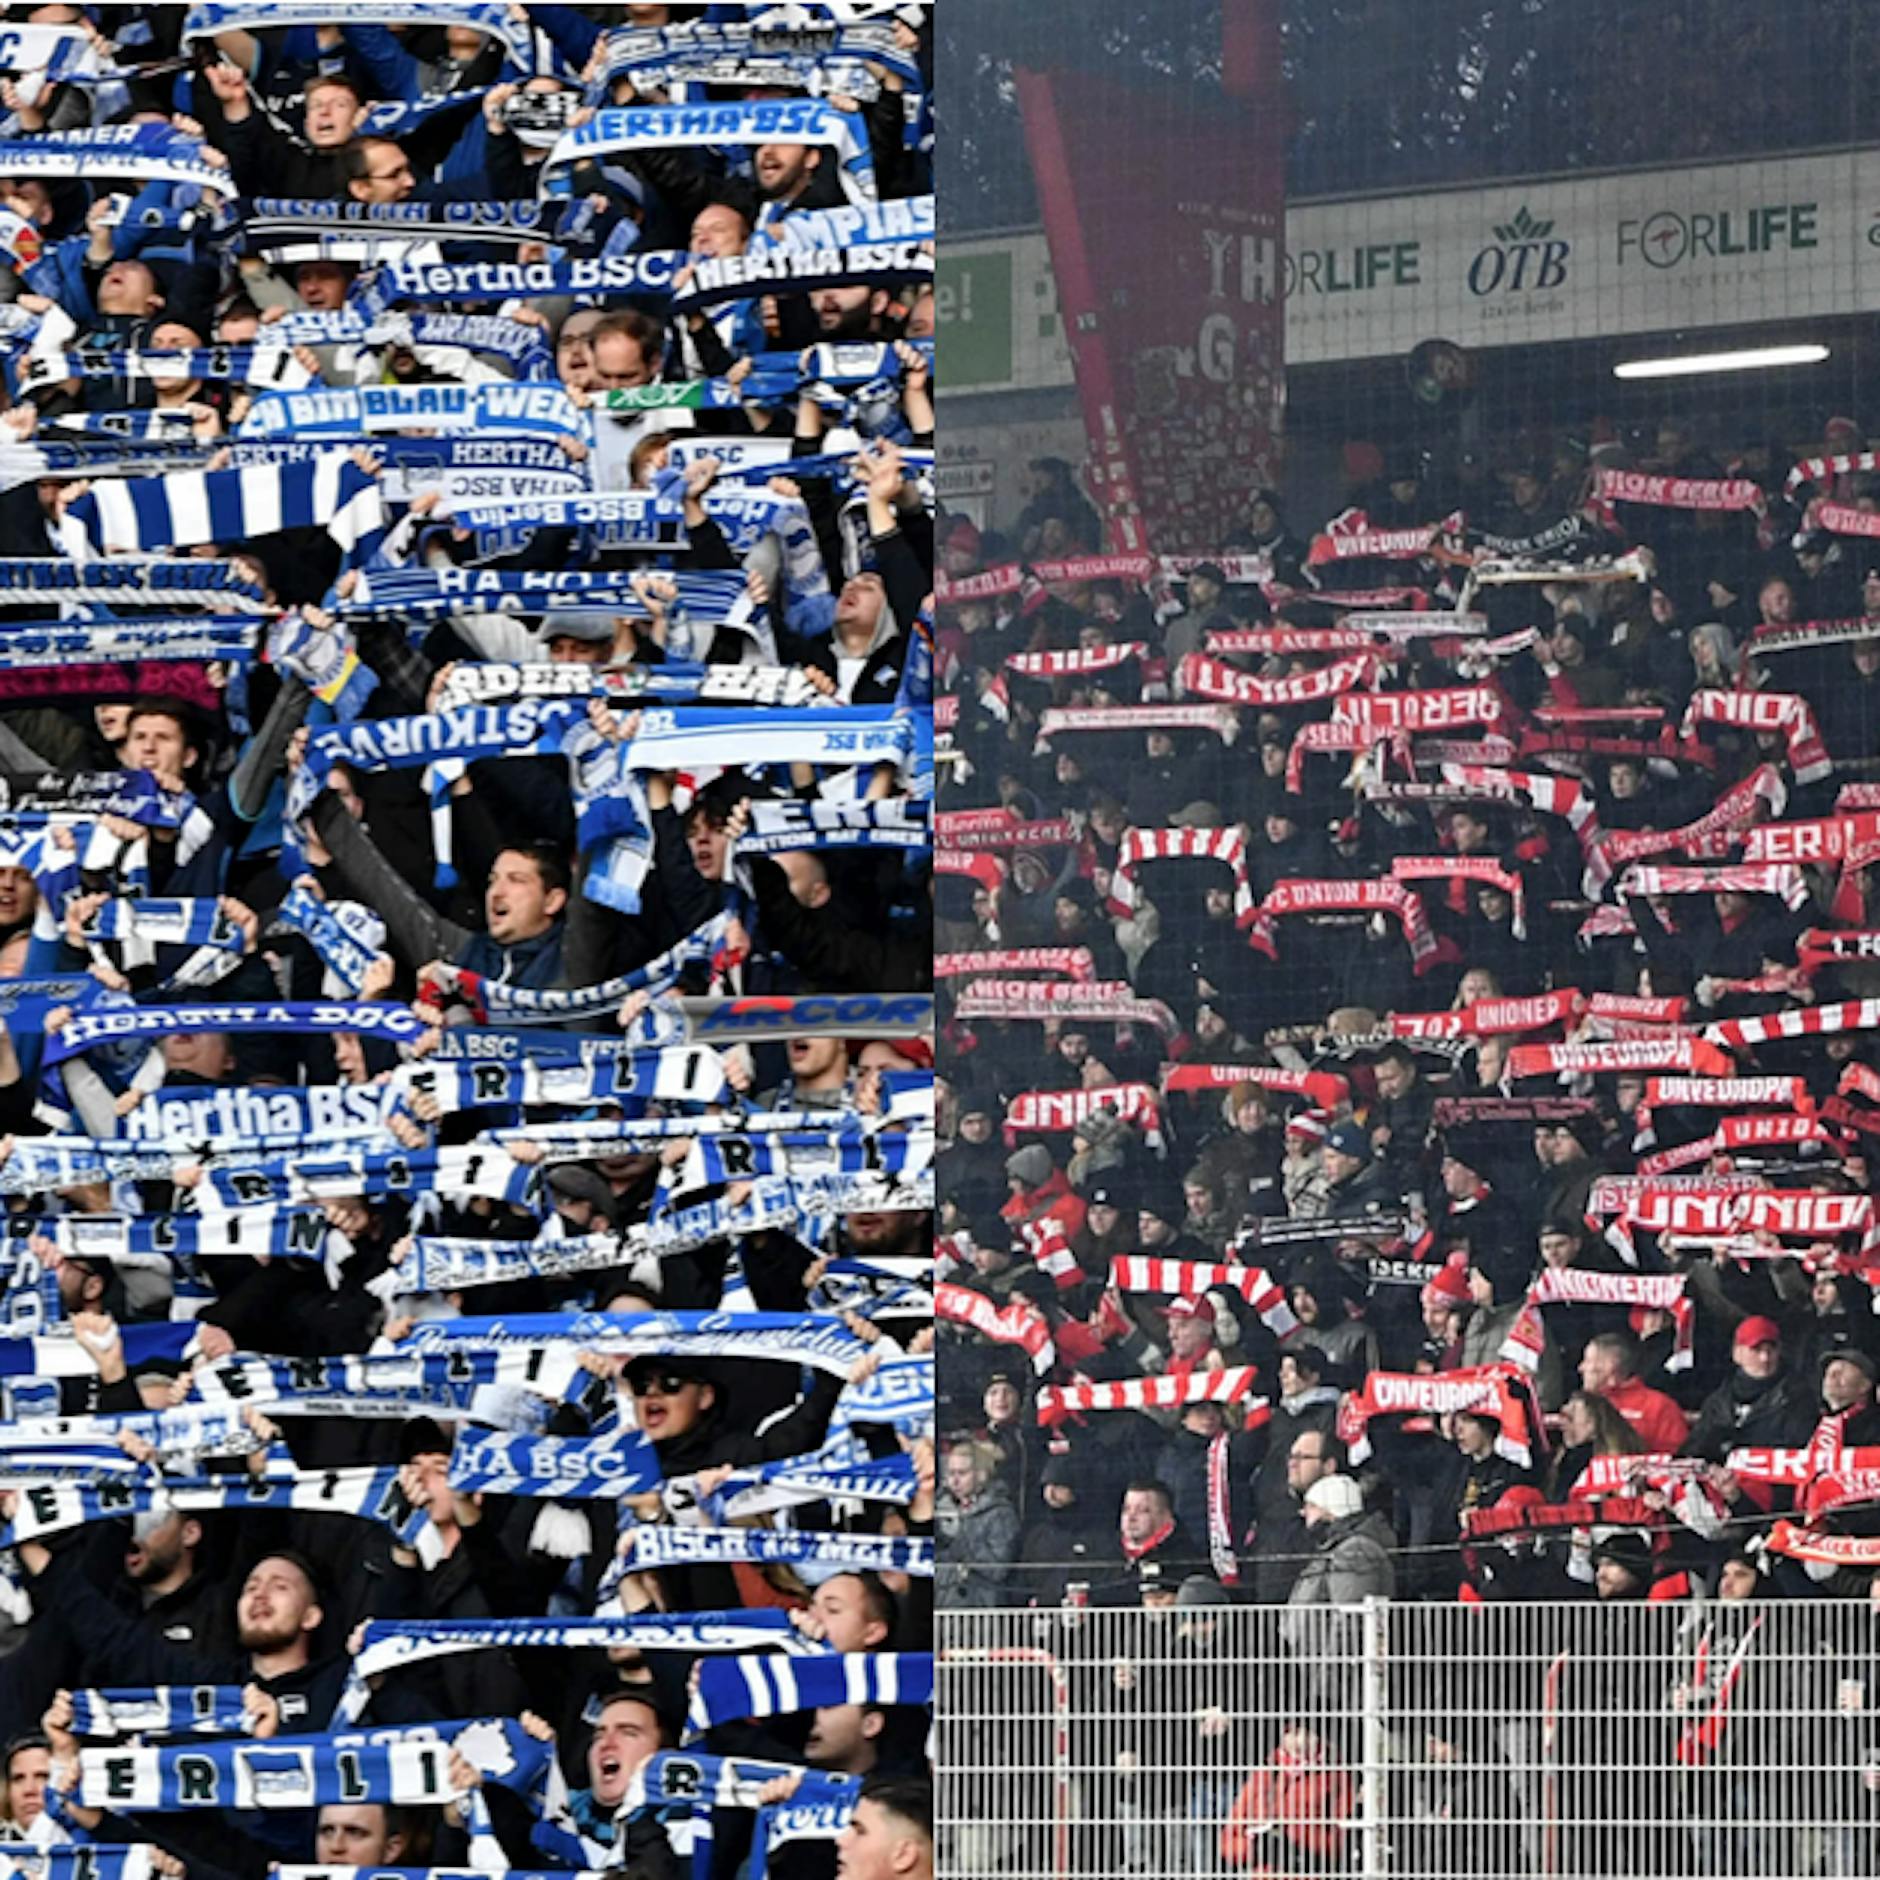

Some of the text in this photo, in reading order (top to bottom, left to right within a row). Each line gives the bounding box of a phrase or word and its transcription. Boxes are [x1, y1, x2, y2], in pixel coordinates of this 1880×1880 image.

[752, 102, 829, 136] BSC
[1617, 202, 1819, 269] FORLIFE
[571, 250, 677, 288] BSC
[1285, 242, 1420, 299] RLIFE
[1467, 240, 1570, 296] OTB
[469, 501, 566, 527] Berlin
[574, 499, 646, 522] BSC
[701, 996, 931, 1031] ARCOR
[127, 1089, 301, 1140] Hertha
[531, 1447, 627, 1480] BSC
